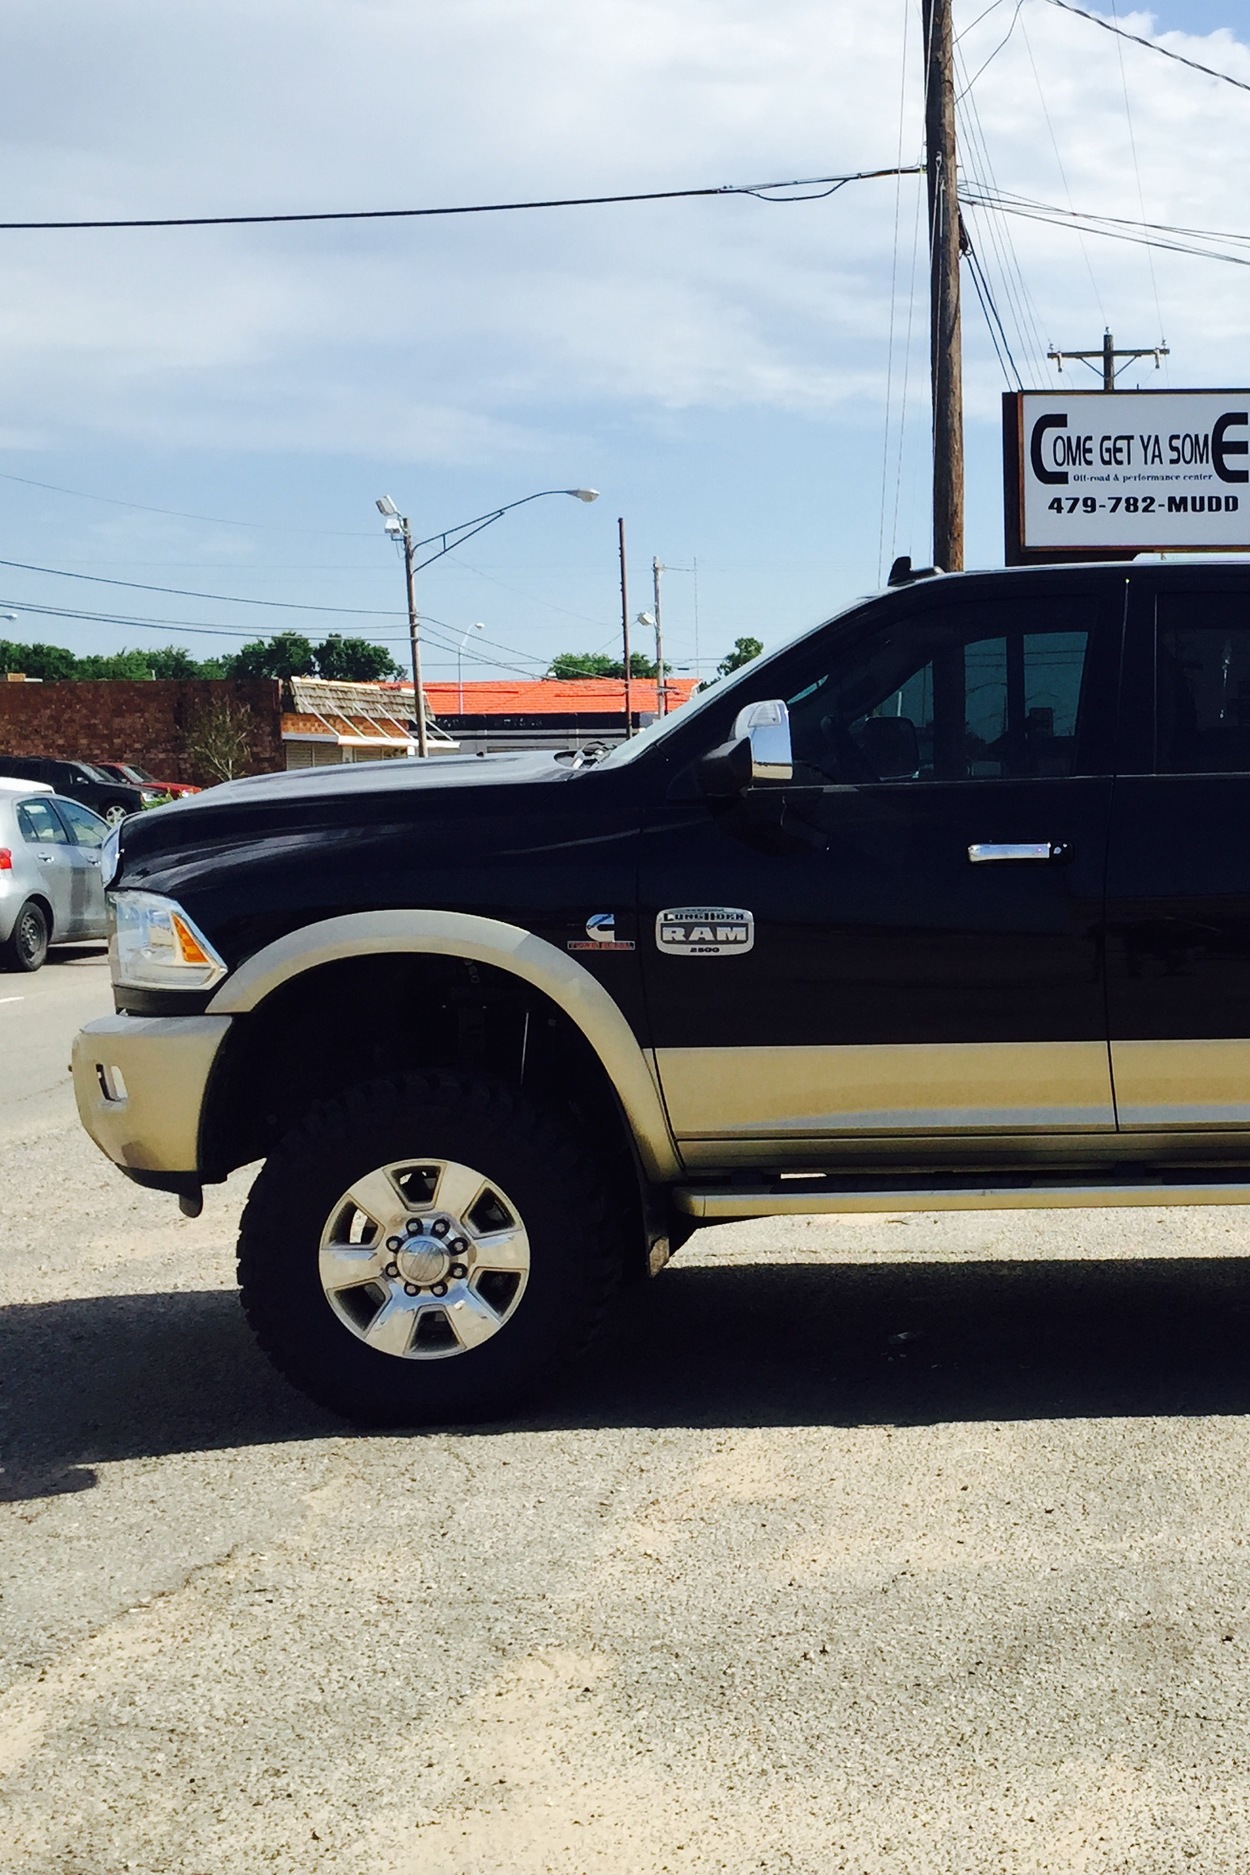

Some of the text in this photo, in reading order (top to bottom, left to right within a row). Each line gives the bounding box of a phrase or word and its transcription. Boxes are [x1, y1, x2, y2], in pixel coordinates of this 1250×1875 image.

[1030, 411, 1250, 485] COME GET YA SOME
[1073, 472, 1213, 484] Off-road & performance center
[1047, 495, 1239, 514] 479-782-MUDD
[662, 926, 747, 941] RAM
